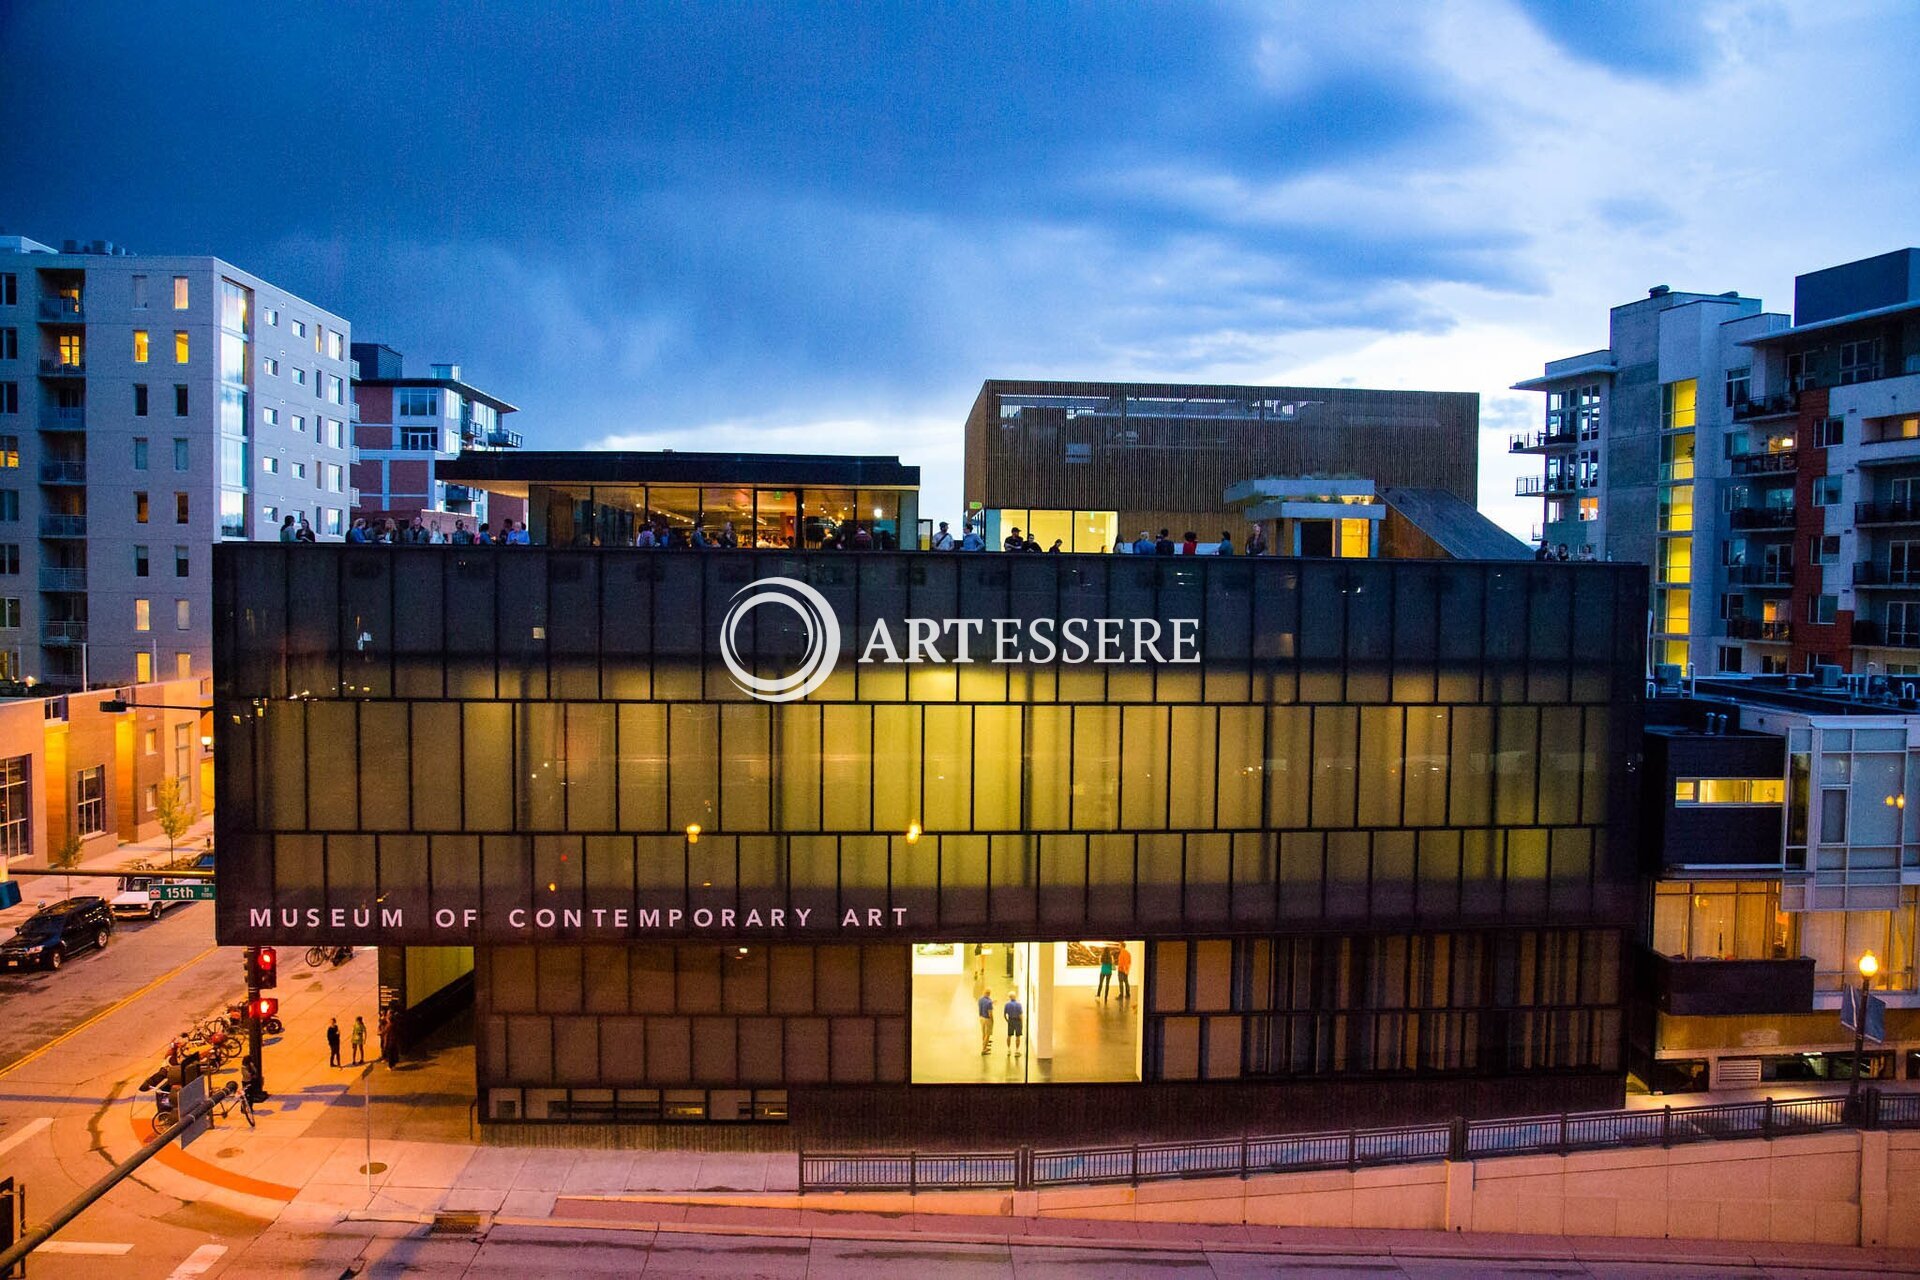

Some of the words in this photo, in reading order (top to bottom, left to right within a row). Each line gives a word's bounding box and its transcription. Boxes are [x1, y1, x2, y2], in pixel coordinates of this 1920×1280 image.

[166, 887, 194, 898] 15th
[250, 908, 403, 928] MUSEUM
[435, 908, 477, 928] OF
[509, 908, 811, 928] CONTEMPORARY
[842, 908, 907, 927] ART
